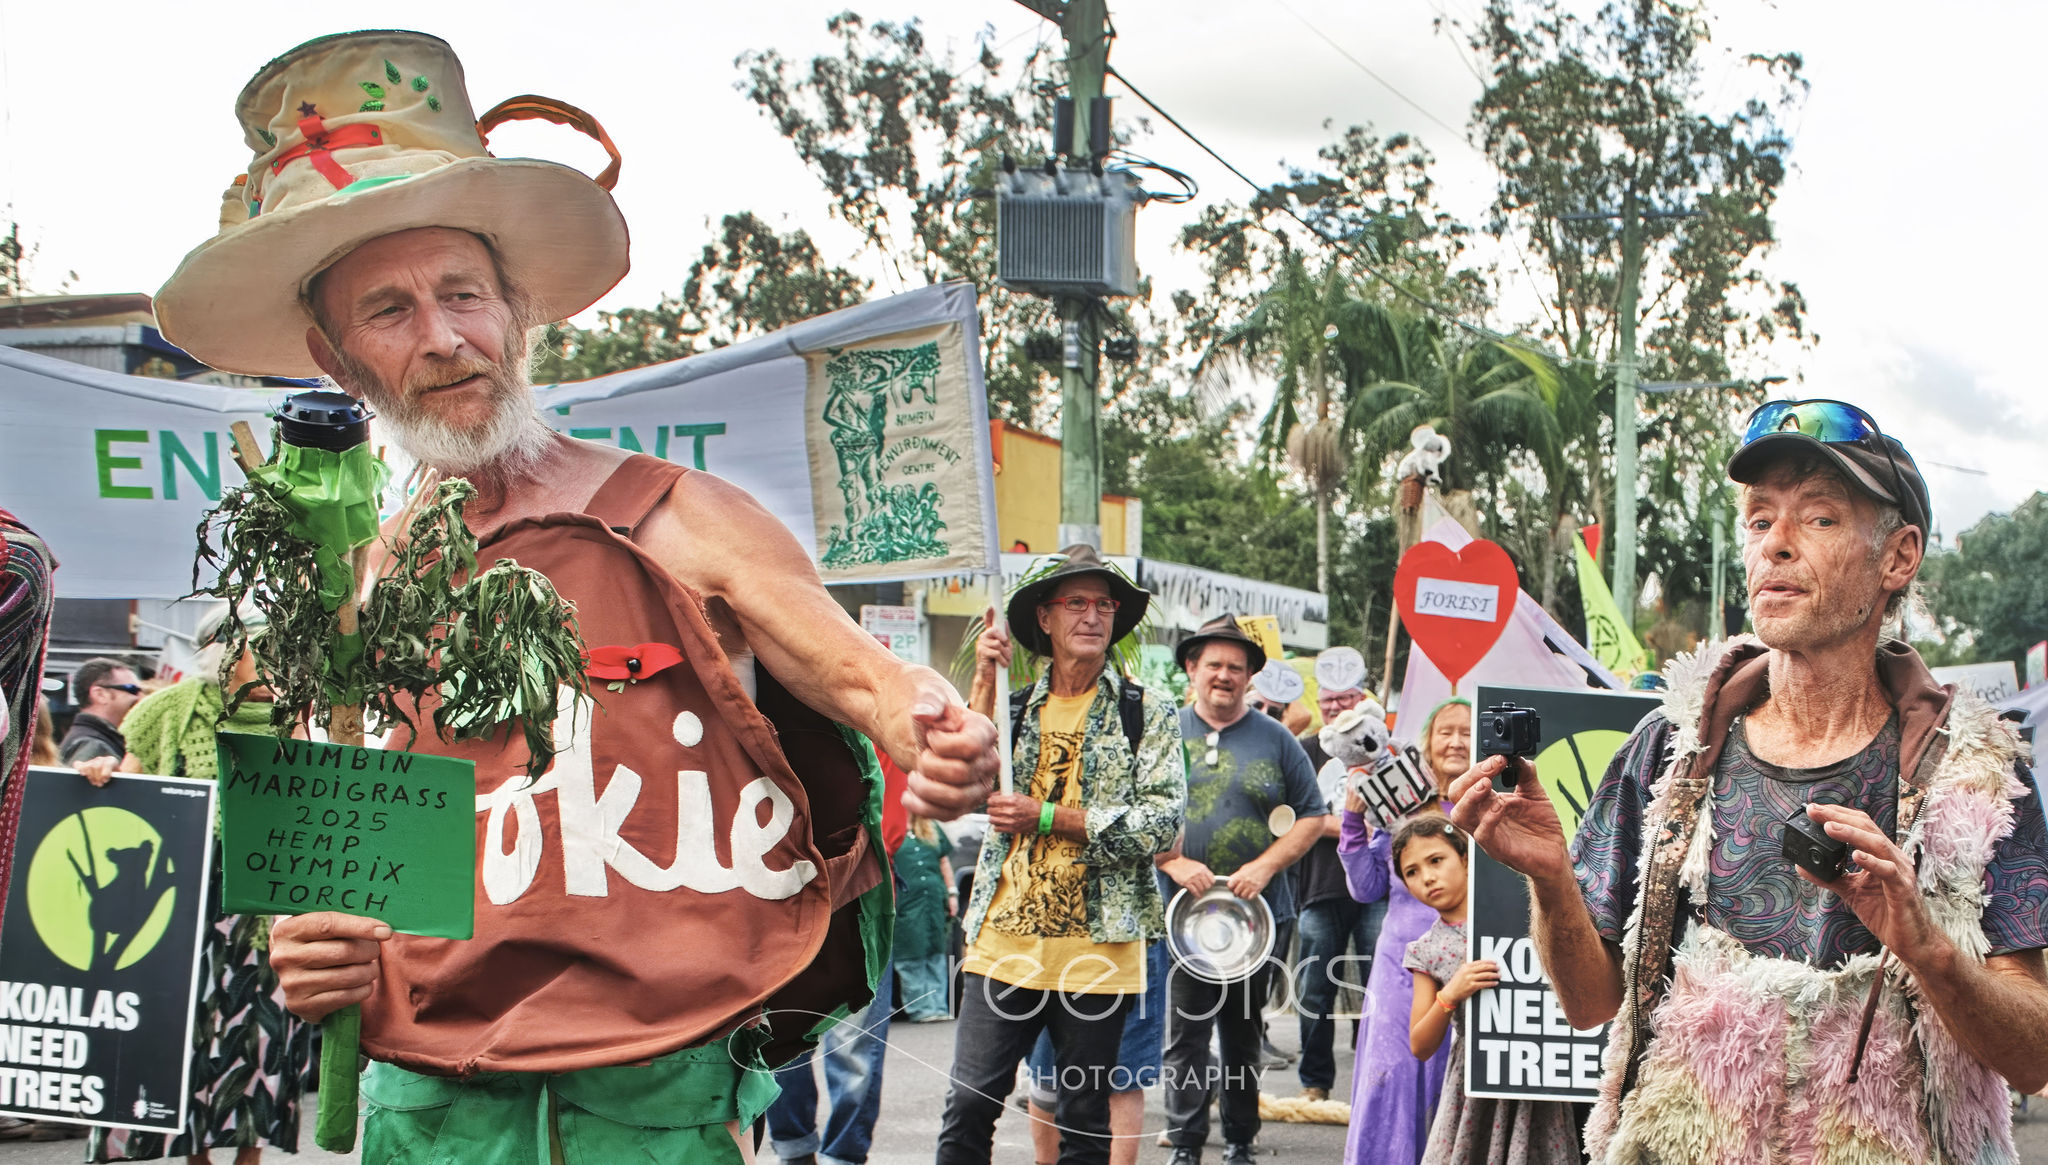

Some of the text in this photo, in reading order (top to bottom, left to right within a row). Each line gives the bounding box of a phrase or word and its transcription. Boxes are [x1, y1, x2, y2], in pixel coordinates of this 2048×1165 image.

[895, 410, 936, 426] NIMBIN
[878, 436, 961, 472] ENVIRONMENT
[902, 463, 936, 475] CENTRE
[1419, 591, 1495, 612] FOREST
[894, 634, 917, 649] 2P
[475, 684, 818, 905] okie
[1358, 746, 1432, 828] HELP
[295, 805, 389, 832] 2025
[267, 828, 360, 854] HEMP
[267, 881, 388, 912] TORCH
[0, 981, 140, 1031] KOALAS
[1479, 988, 1604, 1038] NEE
[0, 1023, 88, 1069] NEED
[1479, 1039, 1608, 1089] TREE
[0, 1067, 104, 1115] TREES
